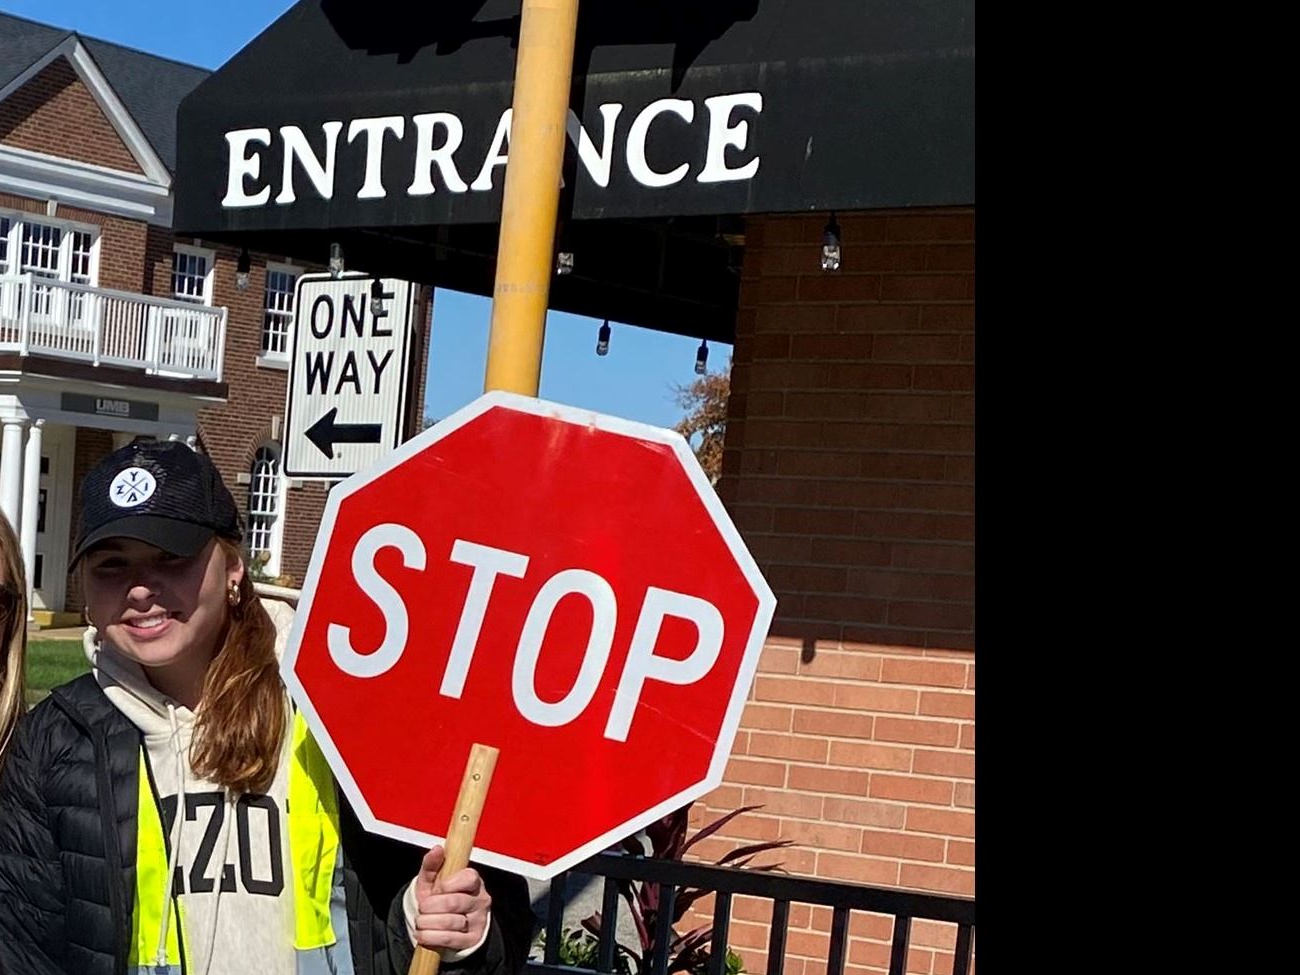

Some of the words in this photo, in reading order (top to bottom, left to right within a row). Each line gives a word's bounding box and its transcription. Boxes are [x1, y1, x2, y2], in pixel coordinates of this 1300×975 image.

[310, 291, 395, 340] ONE
[305, 349, 394, 395] WAY
[326, 522, 725, 743] STOP
